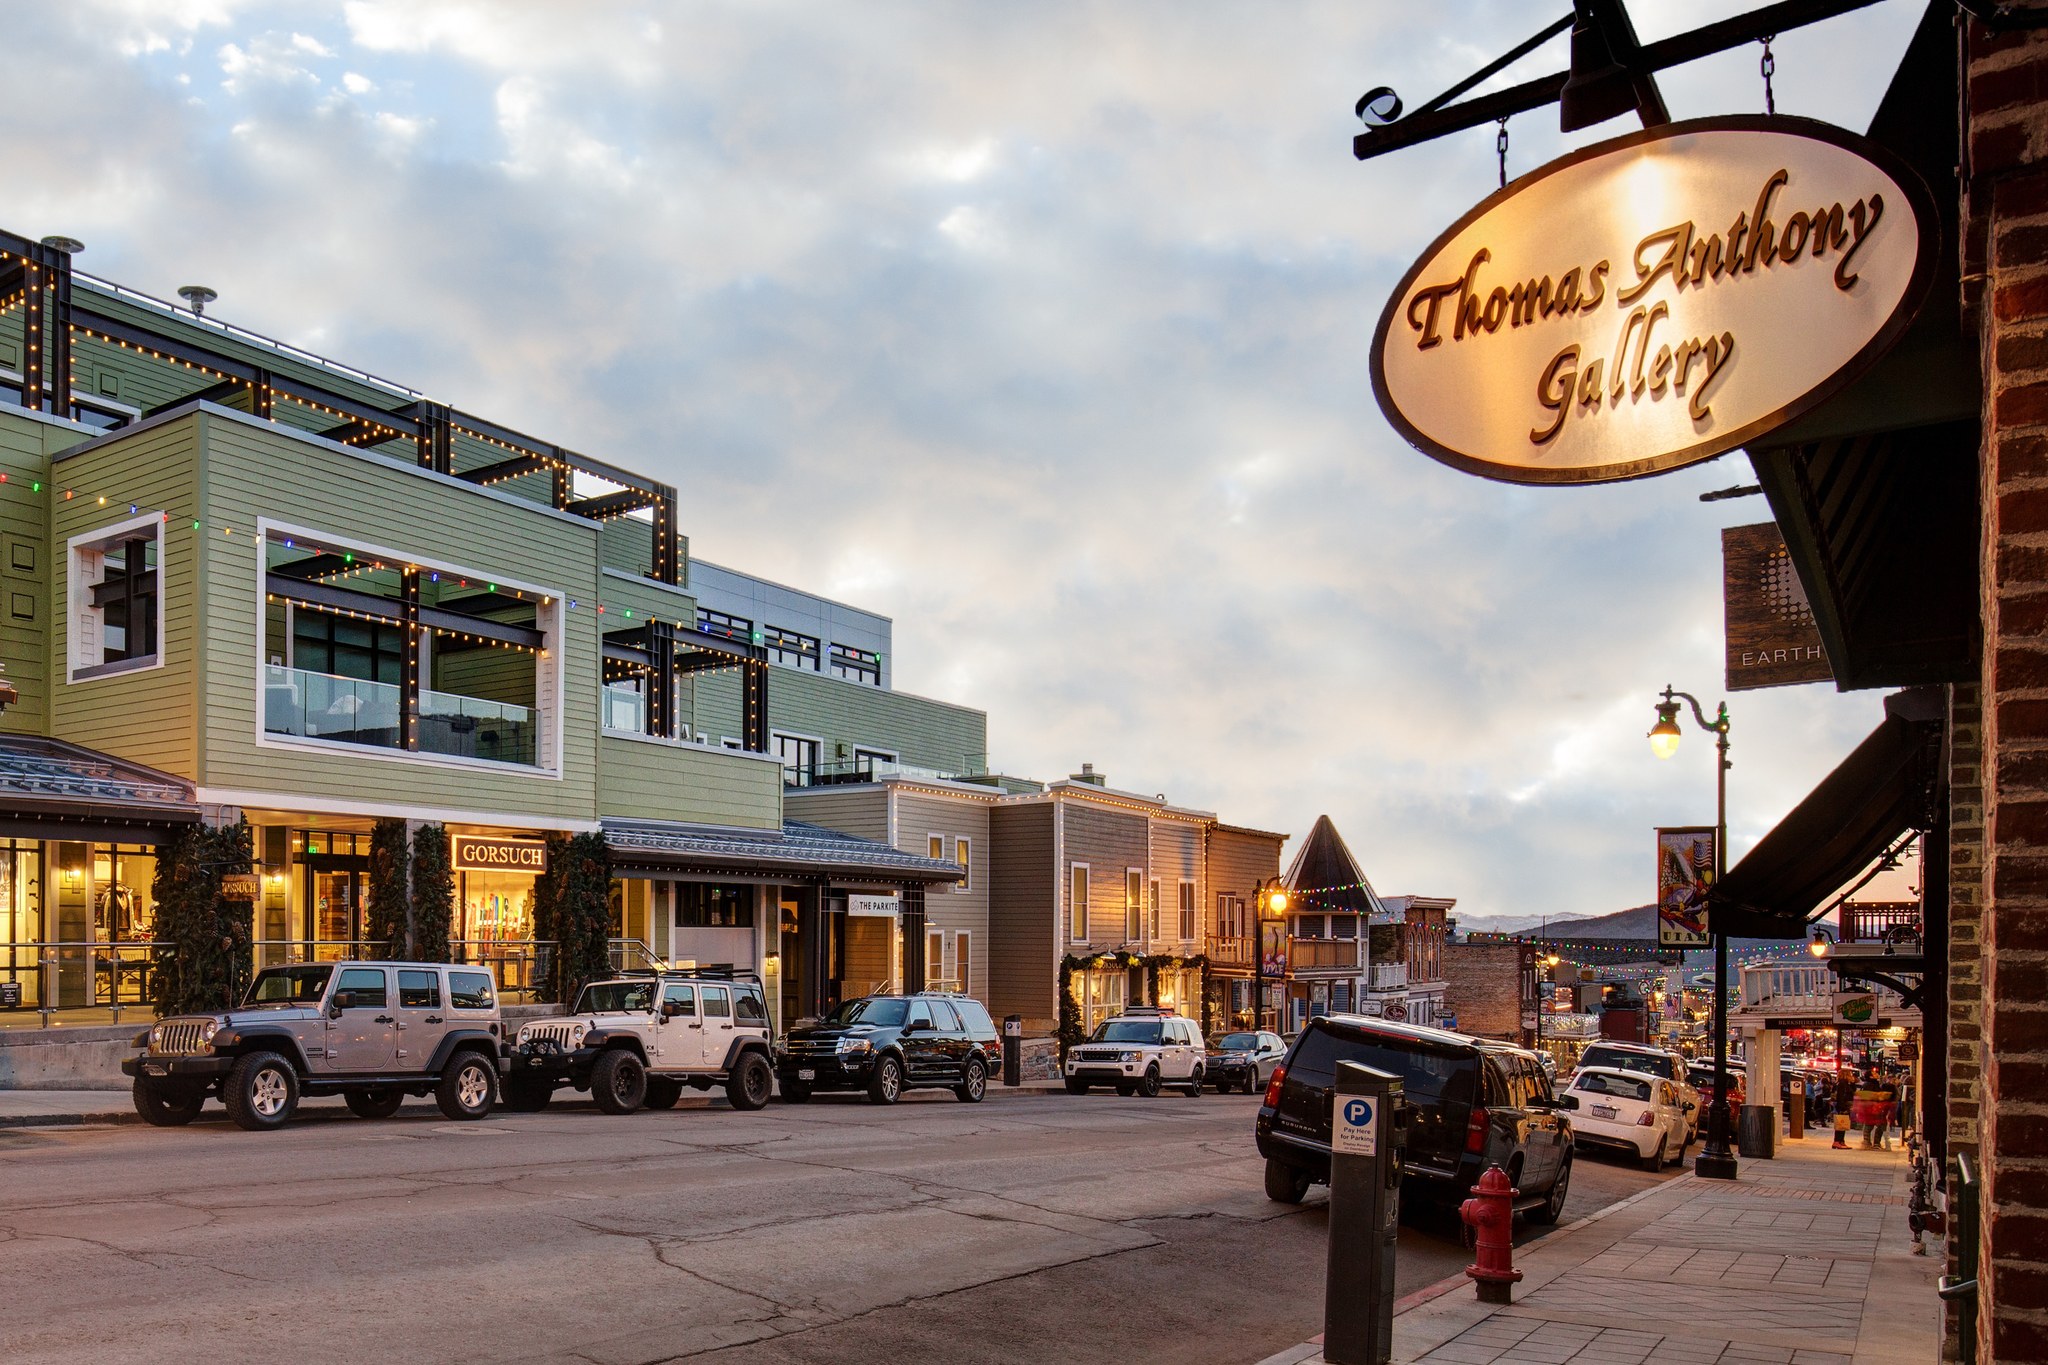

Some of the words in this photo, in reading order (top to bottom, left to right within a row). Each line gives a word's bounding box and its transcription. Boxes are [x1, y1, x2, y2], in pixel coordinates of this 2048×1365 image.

[1407, 247, 1609, 350] Thomas
[1616, 168, 1884, 302] Anthony
[1529, 300, 1734, 444] Gallery
[1742, 645, 1820, 666] EARTH
[463, 844, 543, 865] GORSUCH
[860, 901, 871, 910] THE
[873, 902, 898, 911] PARKITE
[1663, 932, 1707, 941] UTAH
[1351, 1104, 1366, 1121] P
[1281, 1121, 1317, 1133] SUBURBAN
[1351, 1135, 1374, 1143] Parking
